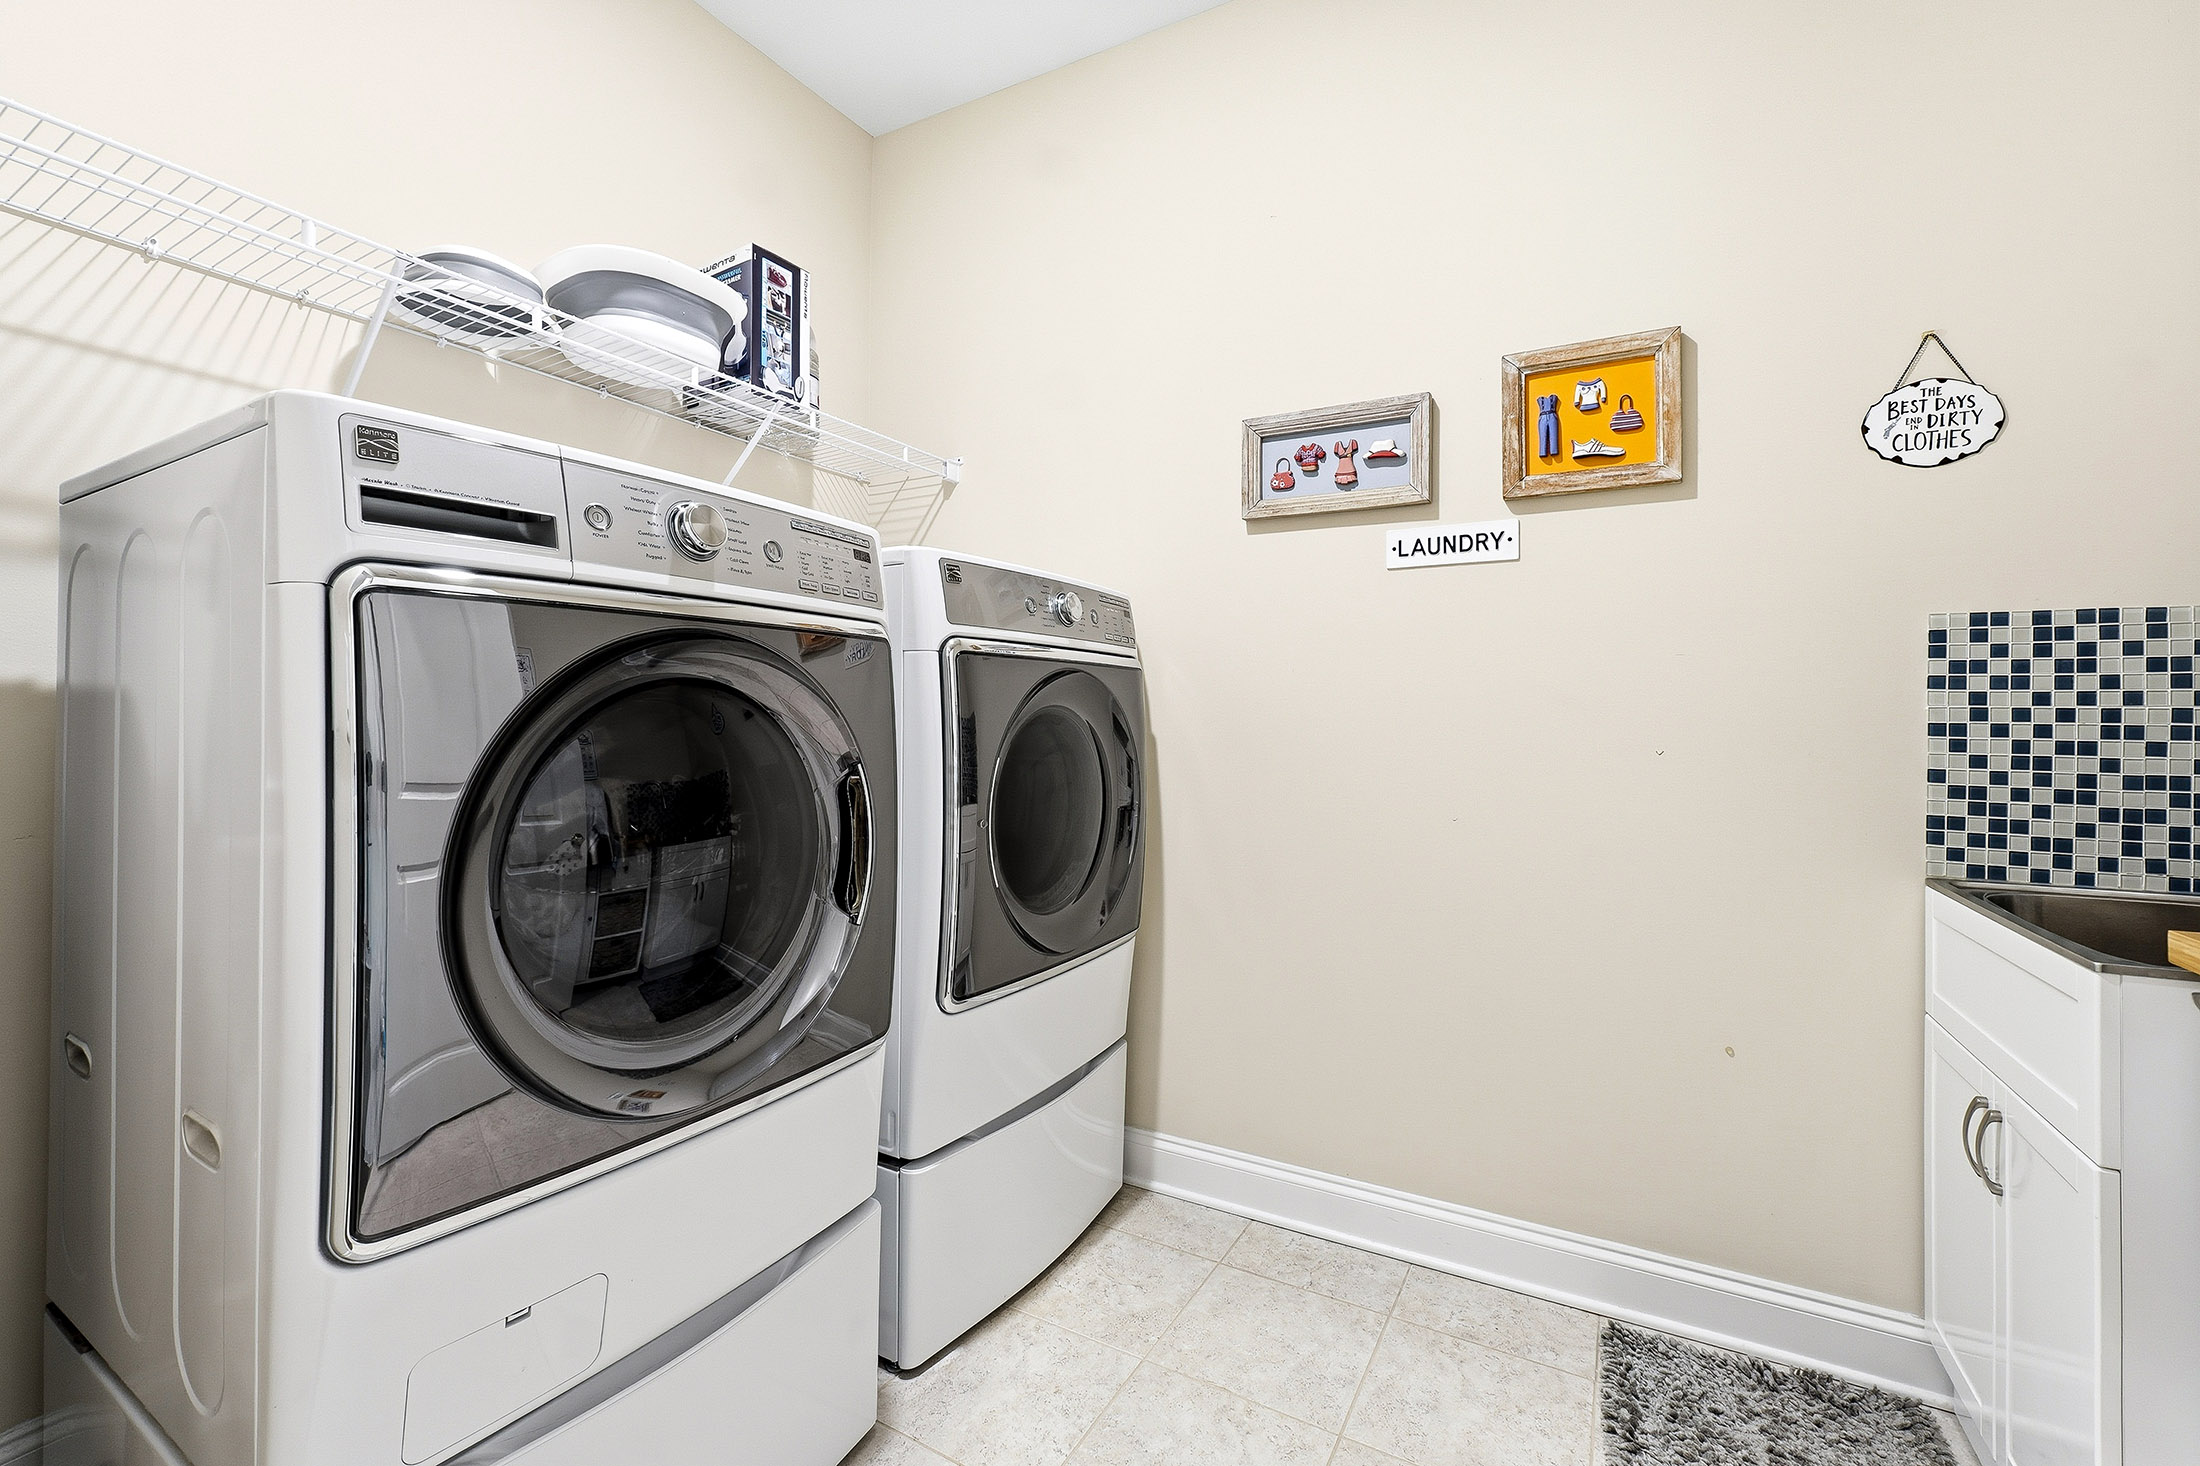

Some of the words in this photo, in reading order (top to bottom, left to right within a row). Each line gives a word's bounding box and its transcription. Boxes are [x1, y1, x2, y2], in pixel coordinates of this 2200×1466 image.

[1920, 386, 1942, 397] THE
[1888, 399, 1928, 421] BEST
[1935, 394, 1976, 411] DAYS
[1927, 408, 1983, 428] DIRTY
[1905, 417, 1922, 425] END
[1892, 429, 1971, 452] CLOTHES
[1398, 531, 1505, 557] LAUNDRY
